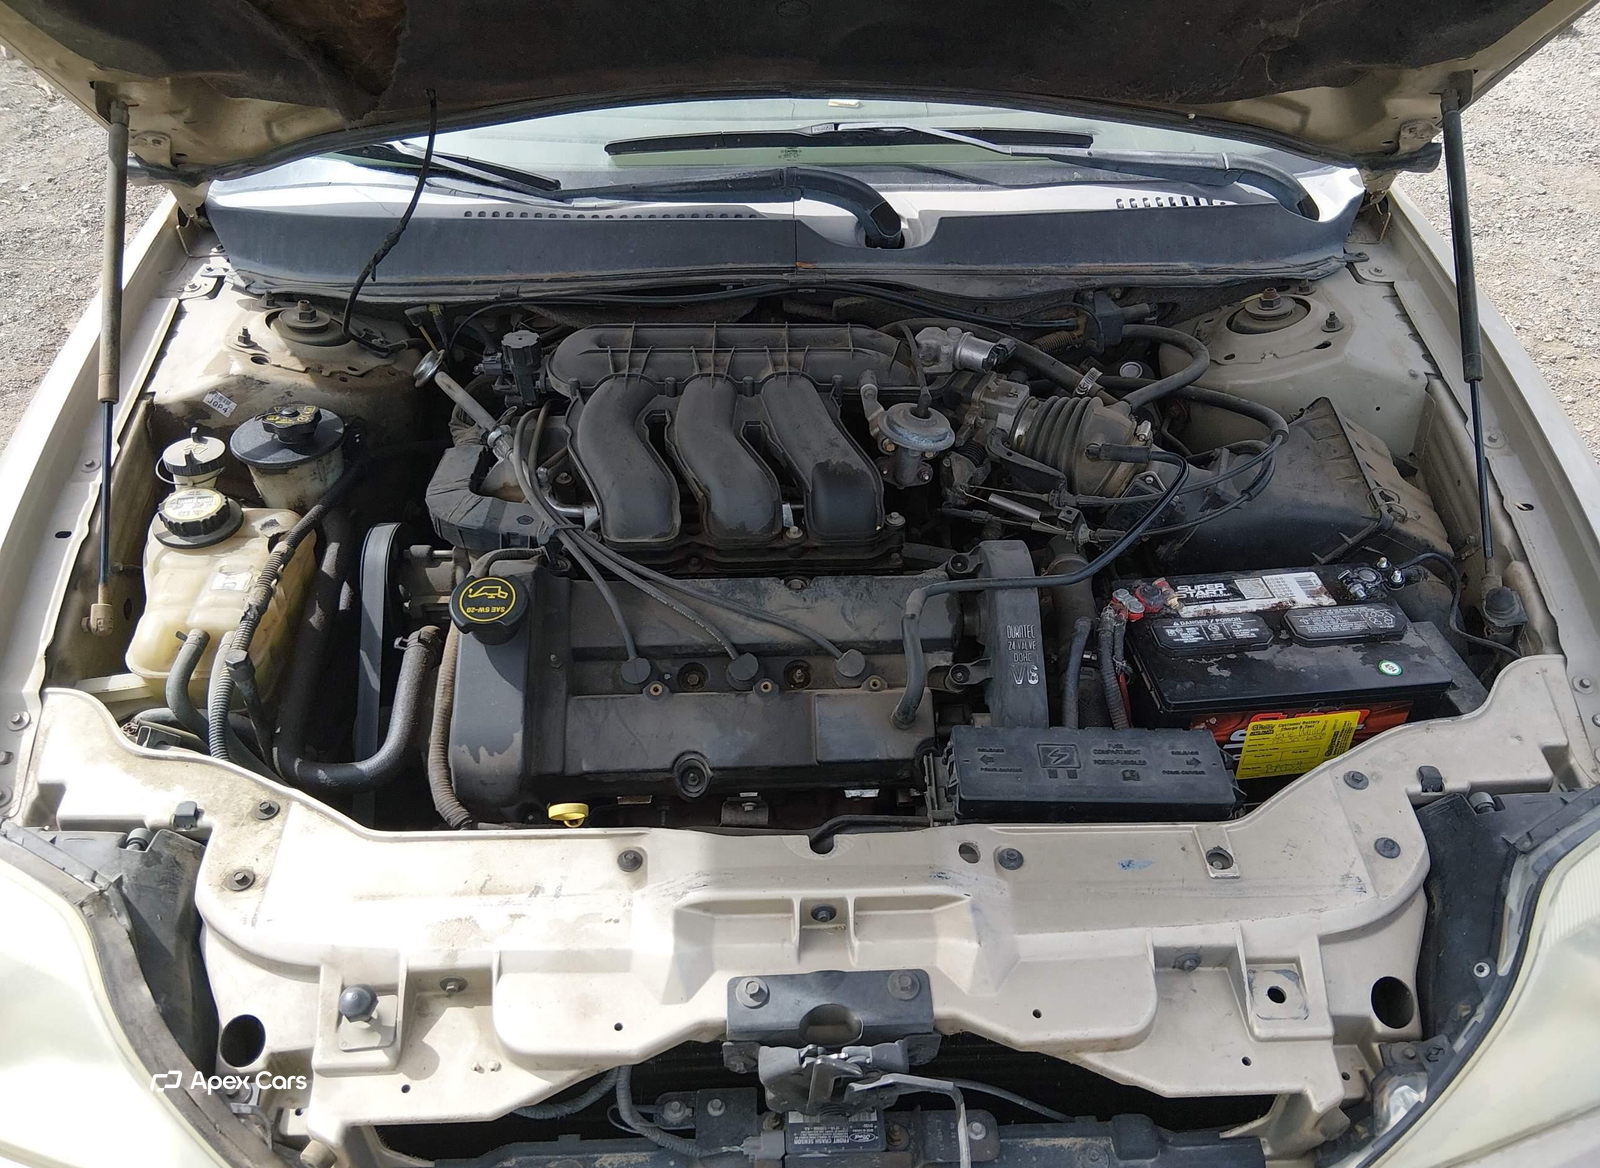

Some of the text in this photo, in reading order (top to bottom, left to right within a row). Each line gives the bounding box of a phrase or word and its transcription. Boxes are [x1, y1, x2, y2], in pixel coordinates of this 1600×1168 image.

[207, 398, 229, 414] JQP4
[1176, 589, 1226, 599] START
[1177, 583, 1226, 593] SUPER
[1006, 624, 1036, 639] DURATEC
[1008, 640, 1036, 650] 24 VALVE
[1011, 664, 1039, 685] V6
